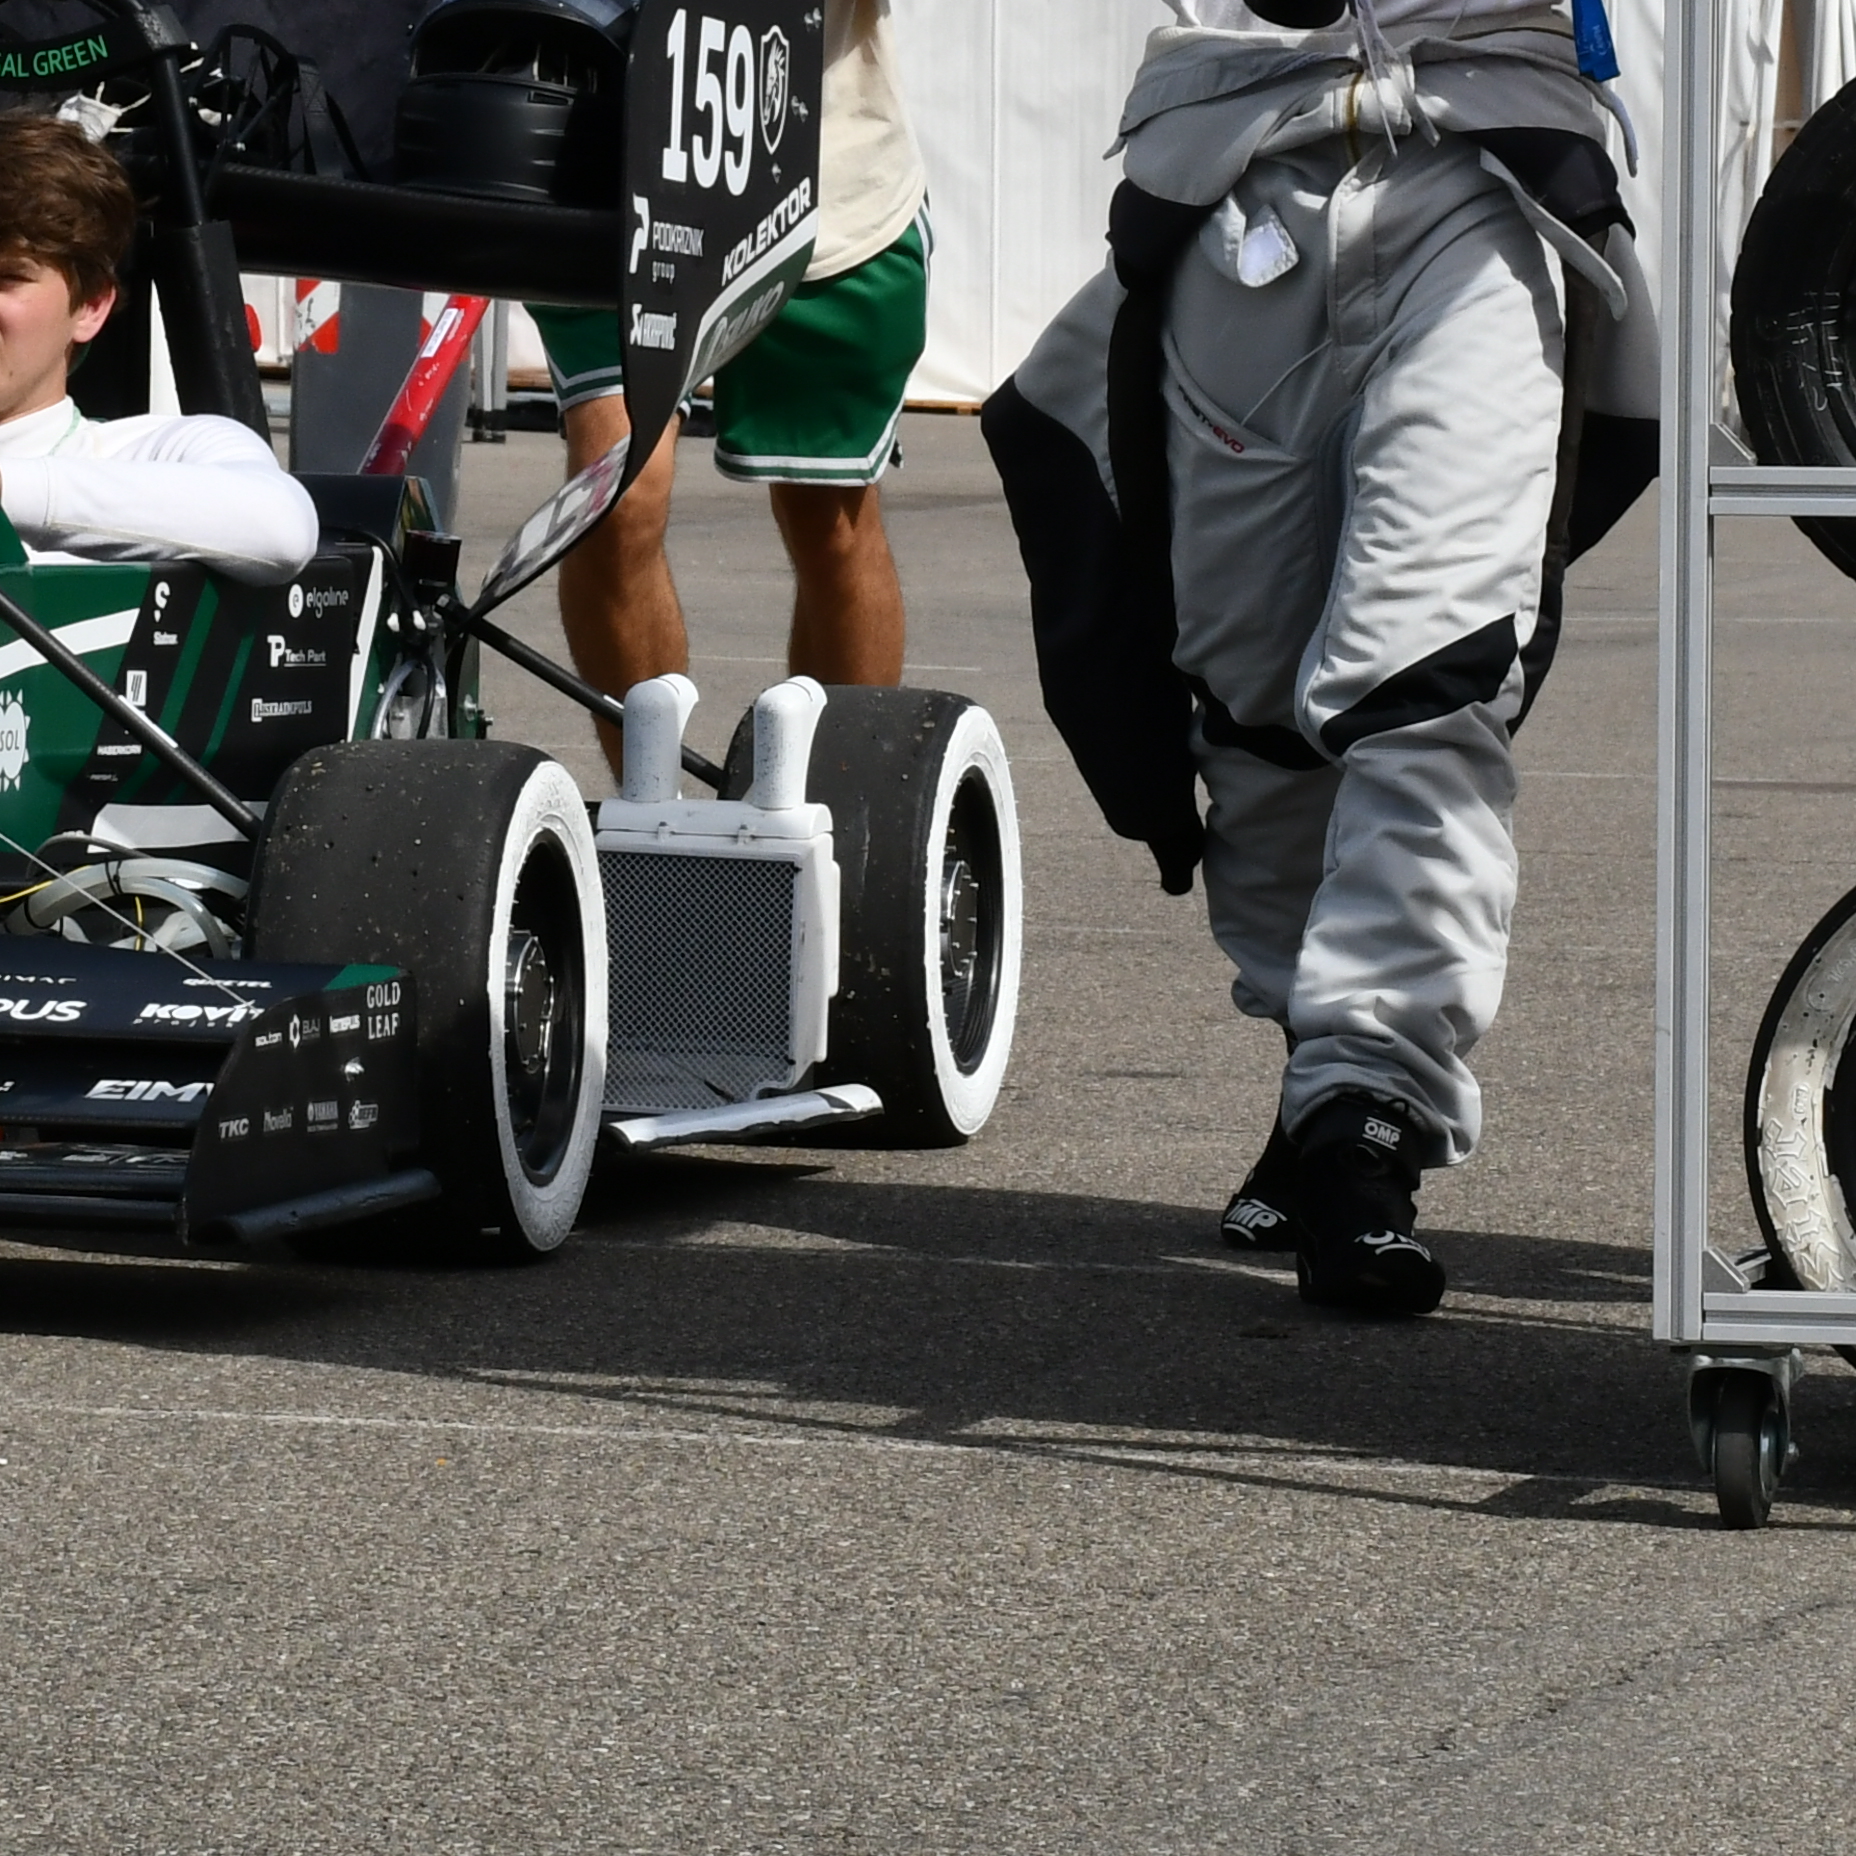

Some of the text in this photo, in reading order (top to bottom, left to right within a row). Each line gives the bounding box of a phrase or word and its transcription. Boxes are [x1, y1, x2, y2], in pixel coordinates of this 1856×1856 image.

[32, 34, 109, 77] GREEN
[662, 8, 755, 196] 159
[721, 176, 813, 288] KOLEKTOR
[652, 261, 676, 284] group
[305, 585, 350, 619] elgoline
[284, 648, 327, 663] Tech Part
[366, 981, 401, 1009] GOLD
[367, 1012, 400, 1040] LEAF
[218, 1117, 250, 1139] TKC
[1363, 1121, 1401, 1145] OMP
